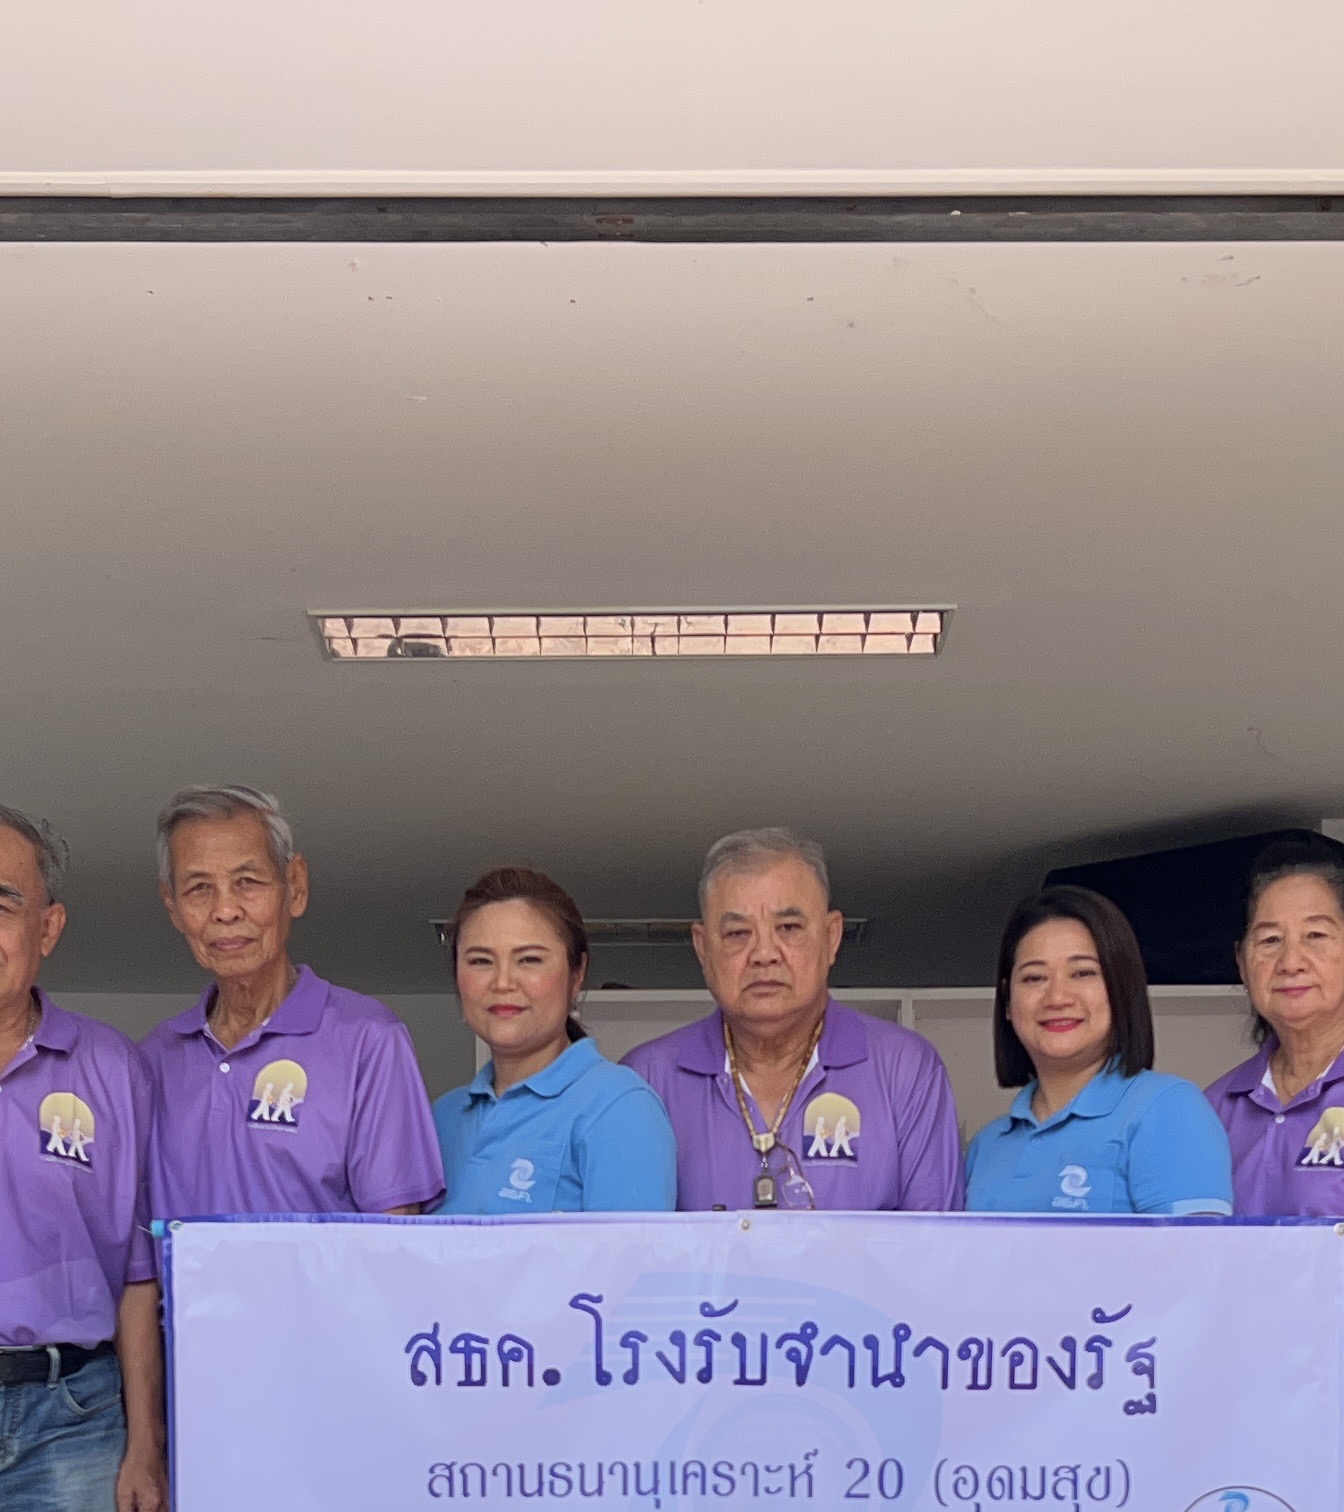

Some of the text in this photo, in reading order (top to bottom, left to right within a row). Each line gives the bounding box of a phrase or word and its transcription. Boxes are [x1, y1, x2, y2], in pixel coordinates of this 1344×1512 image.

[427, 1448, 819, 1509] สถานธนานุเคราะห์
[843, 1457, 904, 1500] 20
